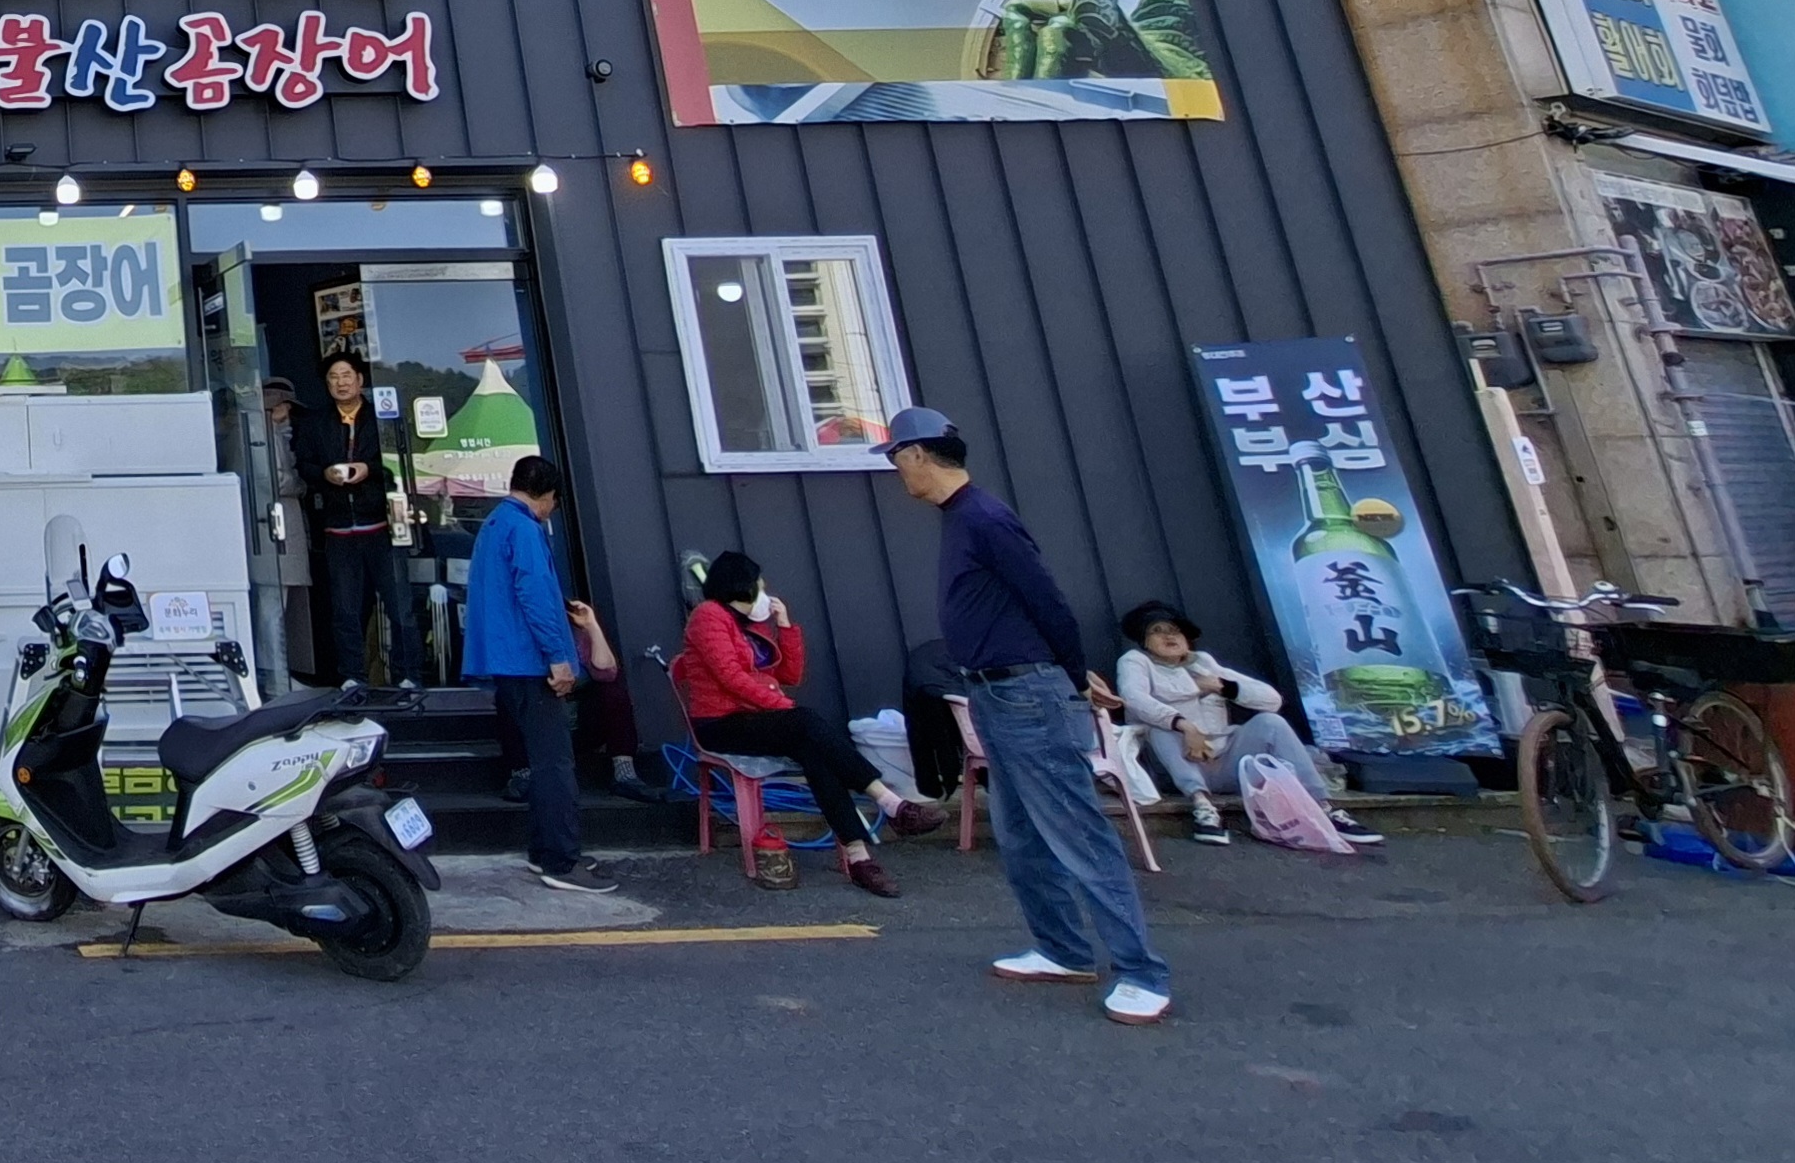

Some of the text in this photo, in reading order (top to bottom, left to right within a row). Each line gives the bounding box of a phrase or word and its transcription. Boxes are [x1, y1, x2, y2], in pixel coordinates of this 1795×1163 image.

[1590, 11, 1685, 93] 활어회
[1677, 13, 1730, 67] 물회
[1, 241, 164, 324] 곰장어
